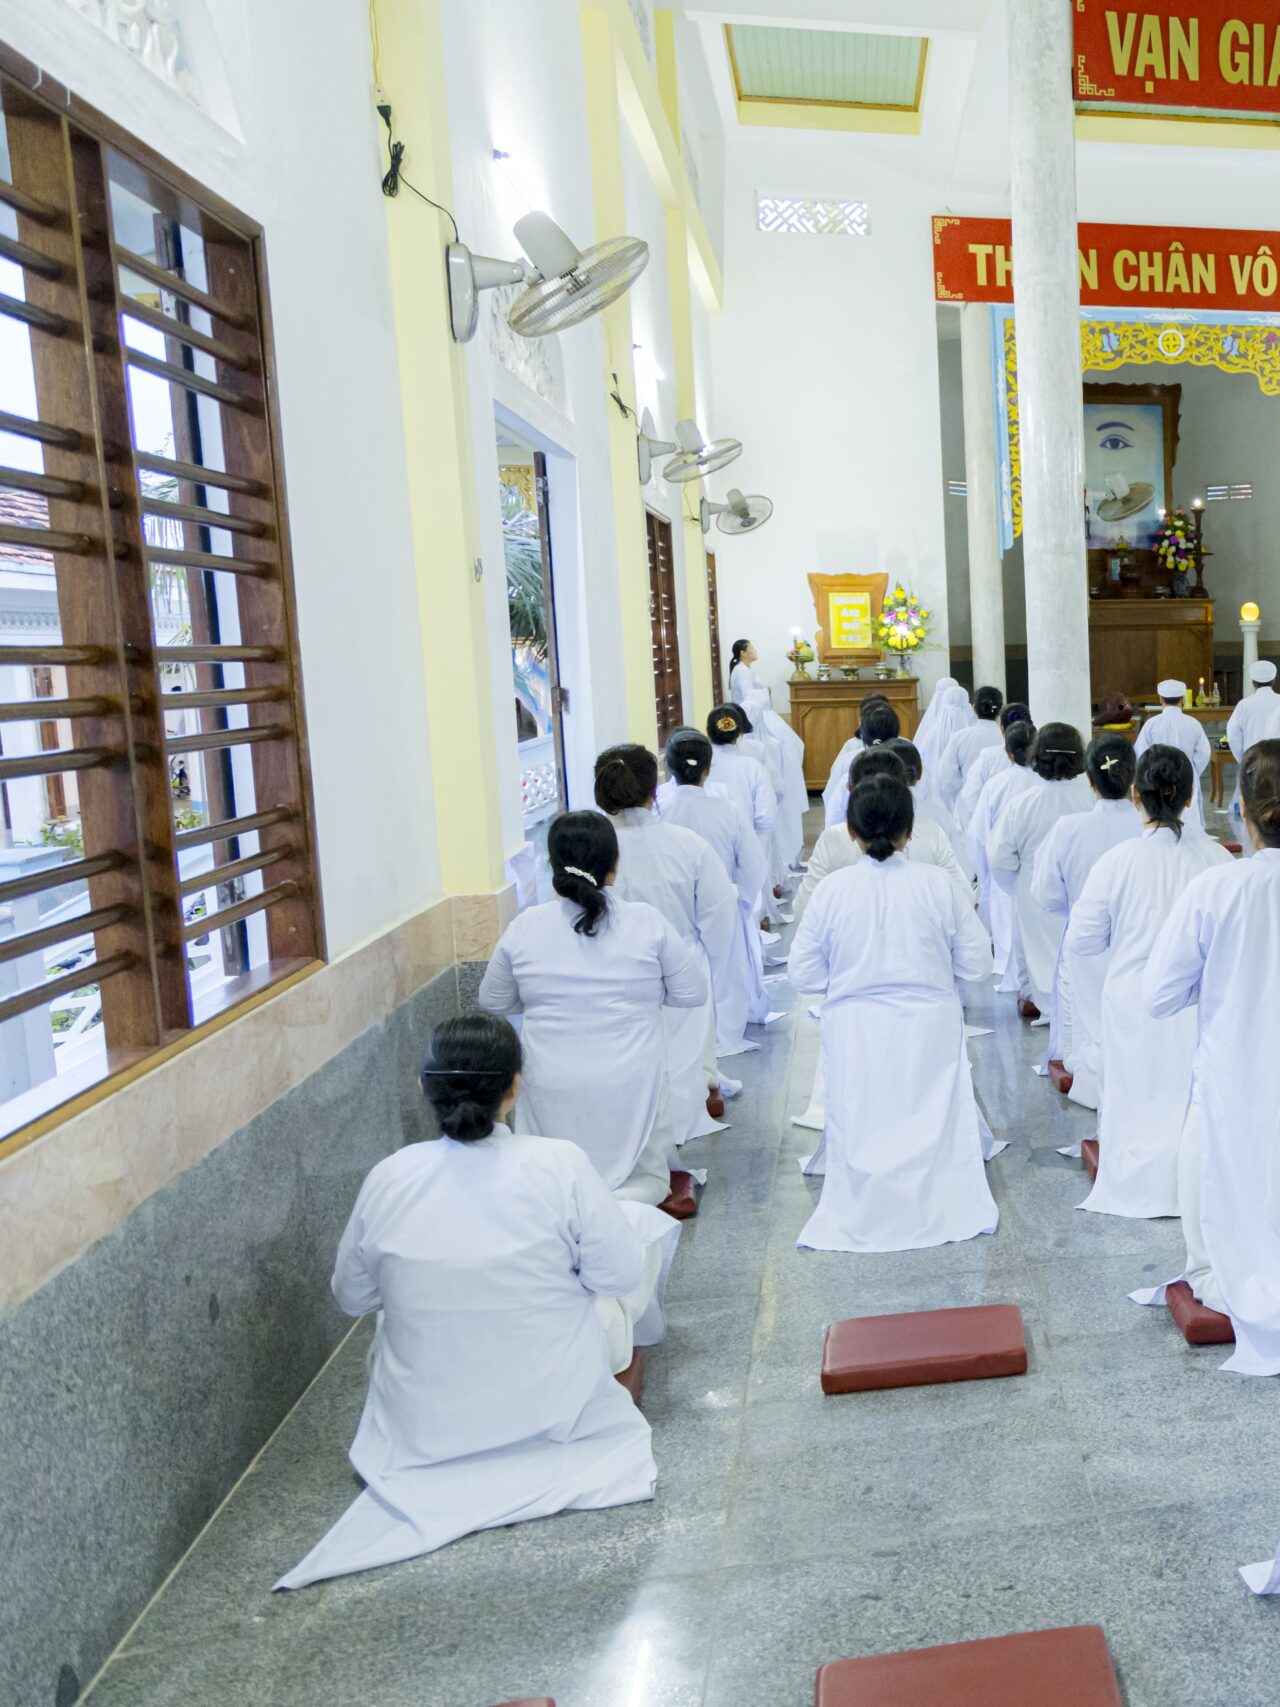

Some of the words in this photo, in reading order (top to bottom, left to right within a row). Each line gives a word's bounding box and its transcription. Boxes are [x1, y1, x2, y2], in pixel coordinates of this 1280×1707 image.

[1105, 11, 1199, 93] VẠN
[1113, 242, 1215, 294] CHÂN
[1229, 246, 1278, 297] VÔ
